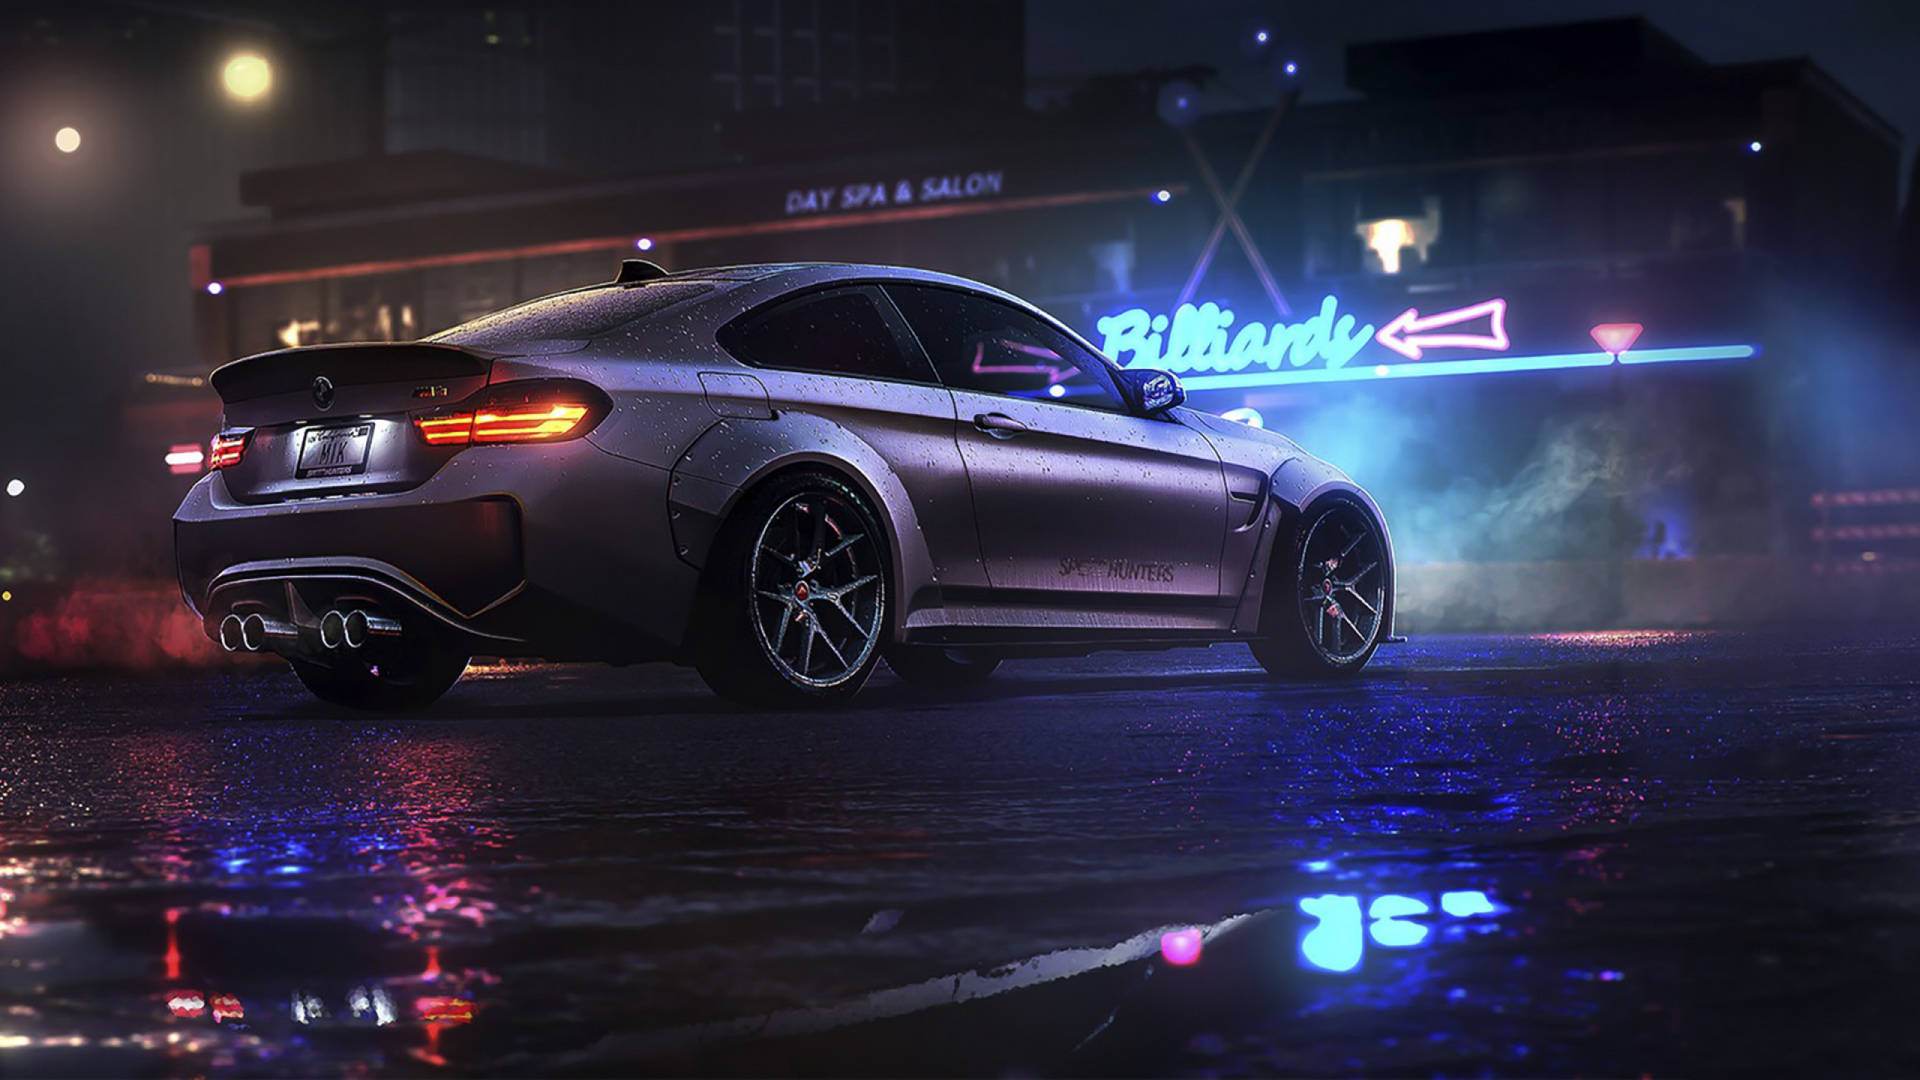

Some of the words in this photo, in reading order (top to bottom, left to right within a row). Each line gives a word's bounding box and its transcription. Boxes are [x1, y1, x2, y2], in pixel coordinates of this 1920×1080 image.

[786, 188, 833, 213] DAY
[841, 183, 886, 208] SPA
[895, 179, 913, 203] &
[921, 172, 1003, 200] SALON
[1097, 294, 1374, 372] Billiards
